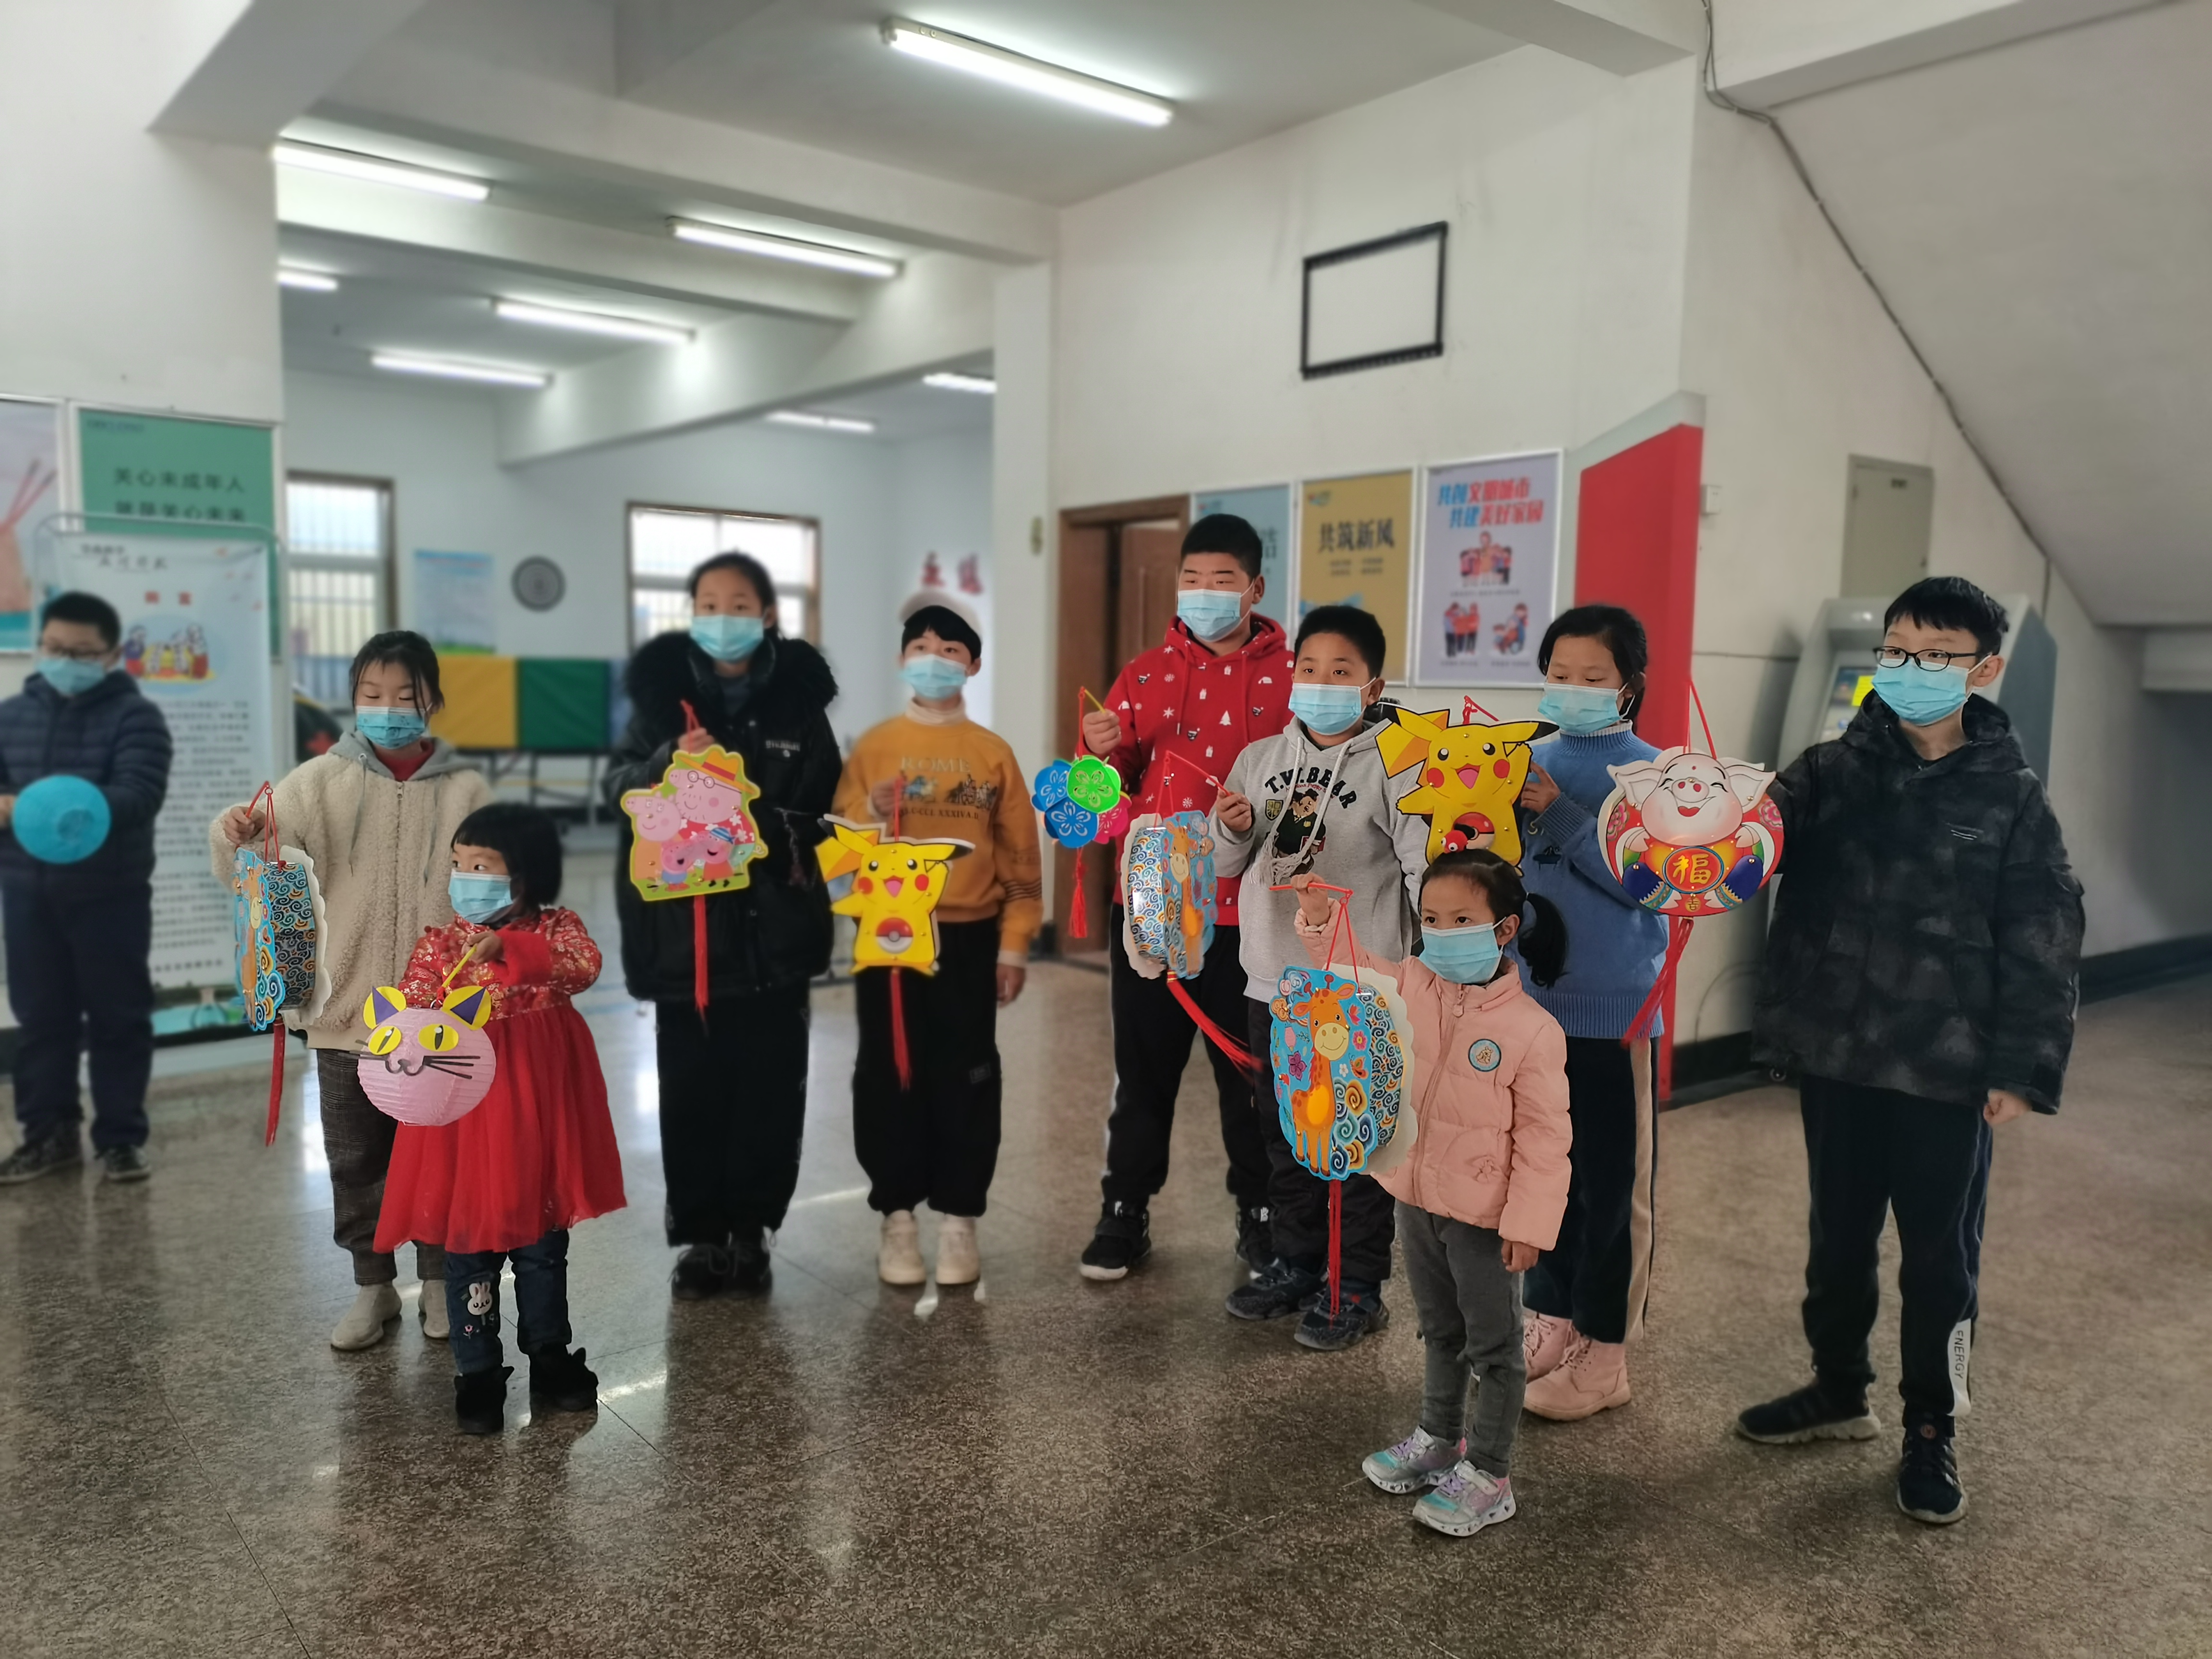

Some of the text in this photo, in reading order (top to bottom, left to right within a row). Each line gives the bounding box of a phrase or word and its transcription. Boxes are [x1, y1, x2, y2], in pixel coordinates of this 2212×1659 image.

[1319, 517, 1395, 553] 共筑新风
[901, 757, 970, 772] ROME
[1672, 854, 1712, 884] 福
[1954, 1330, 1964, 1379] ENERGY
